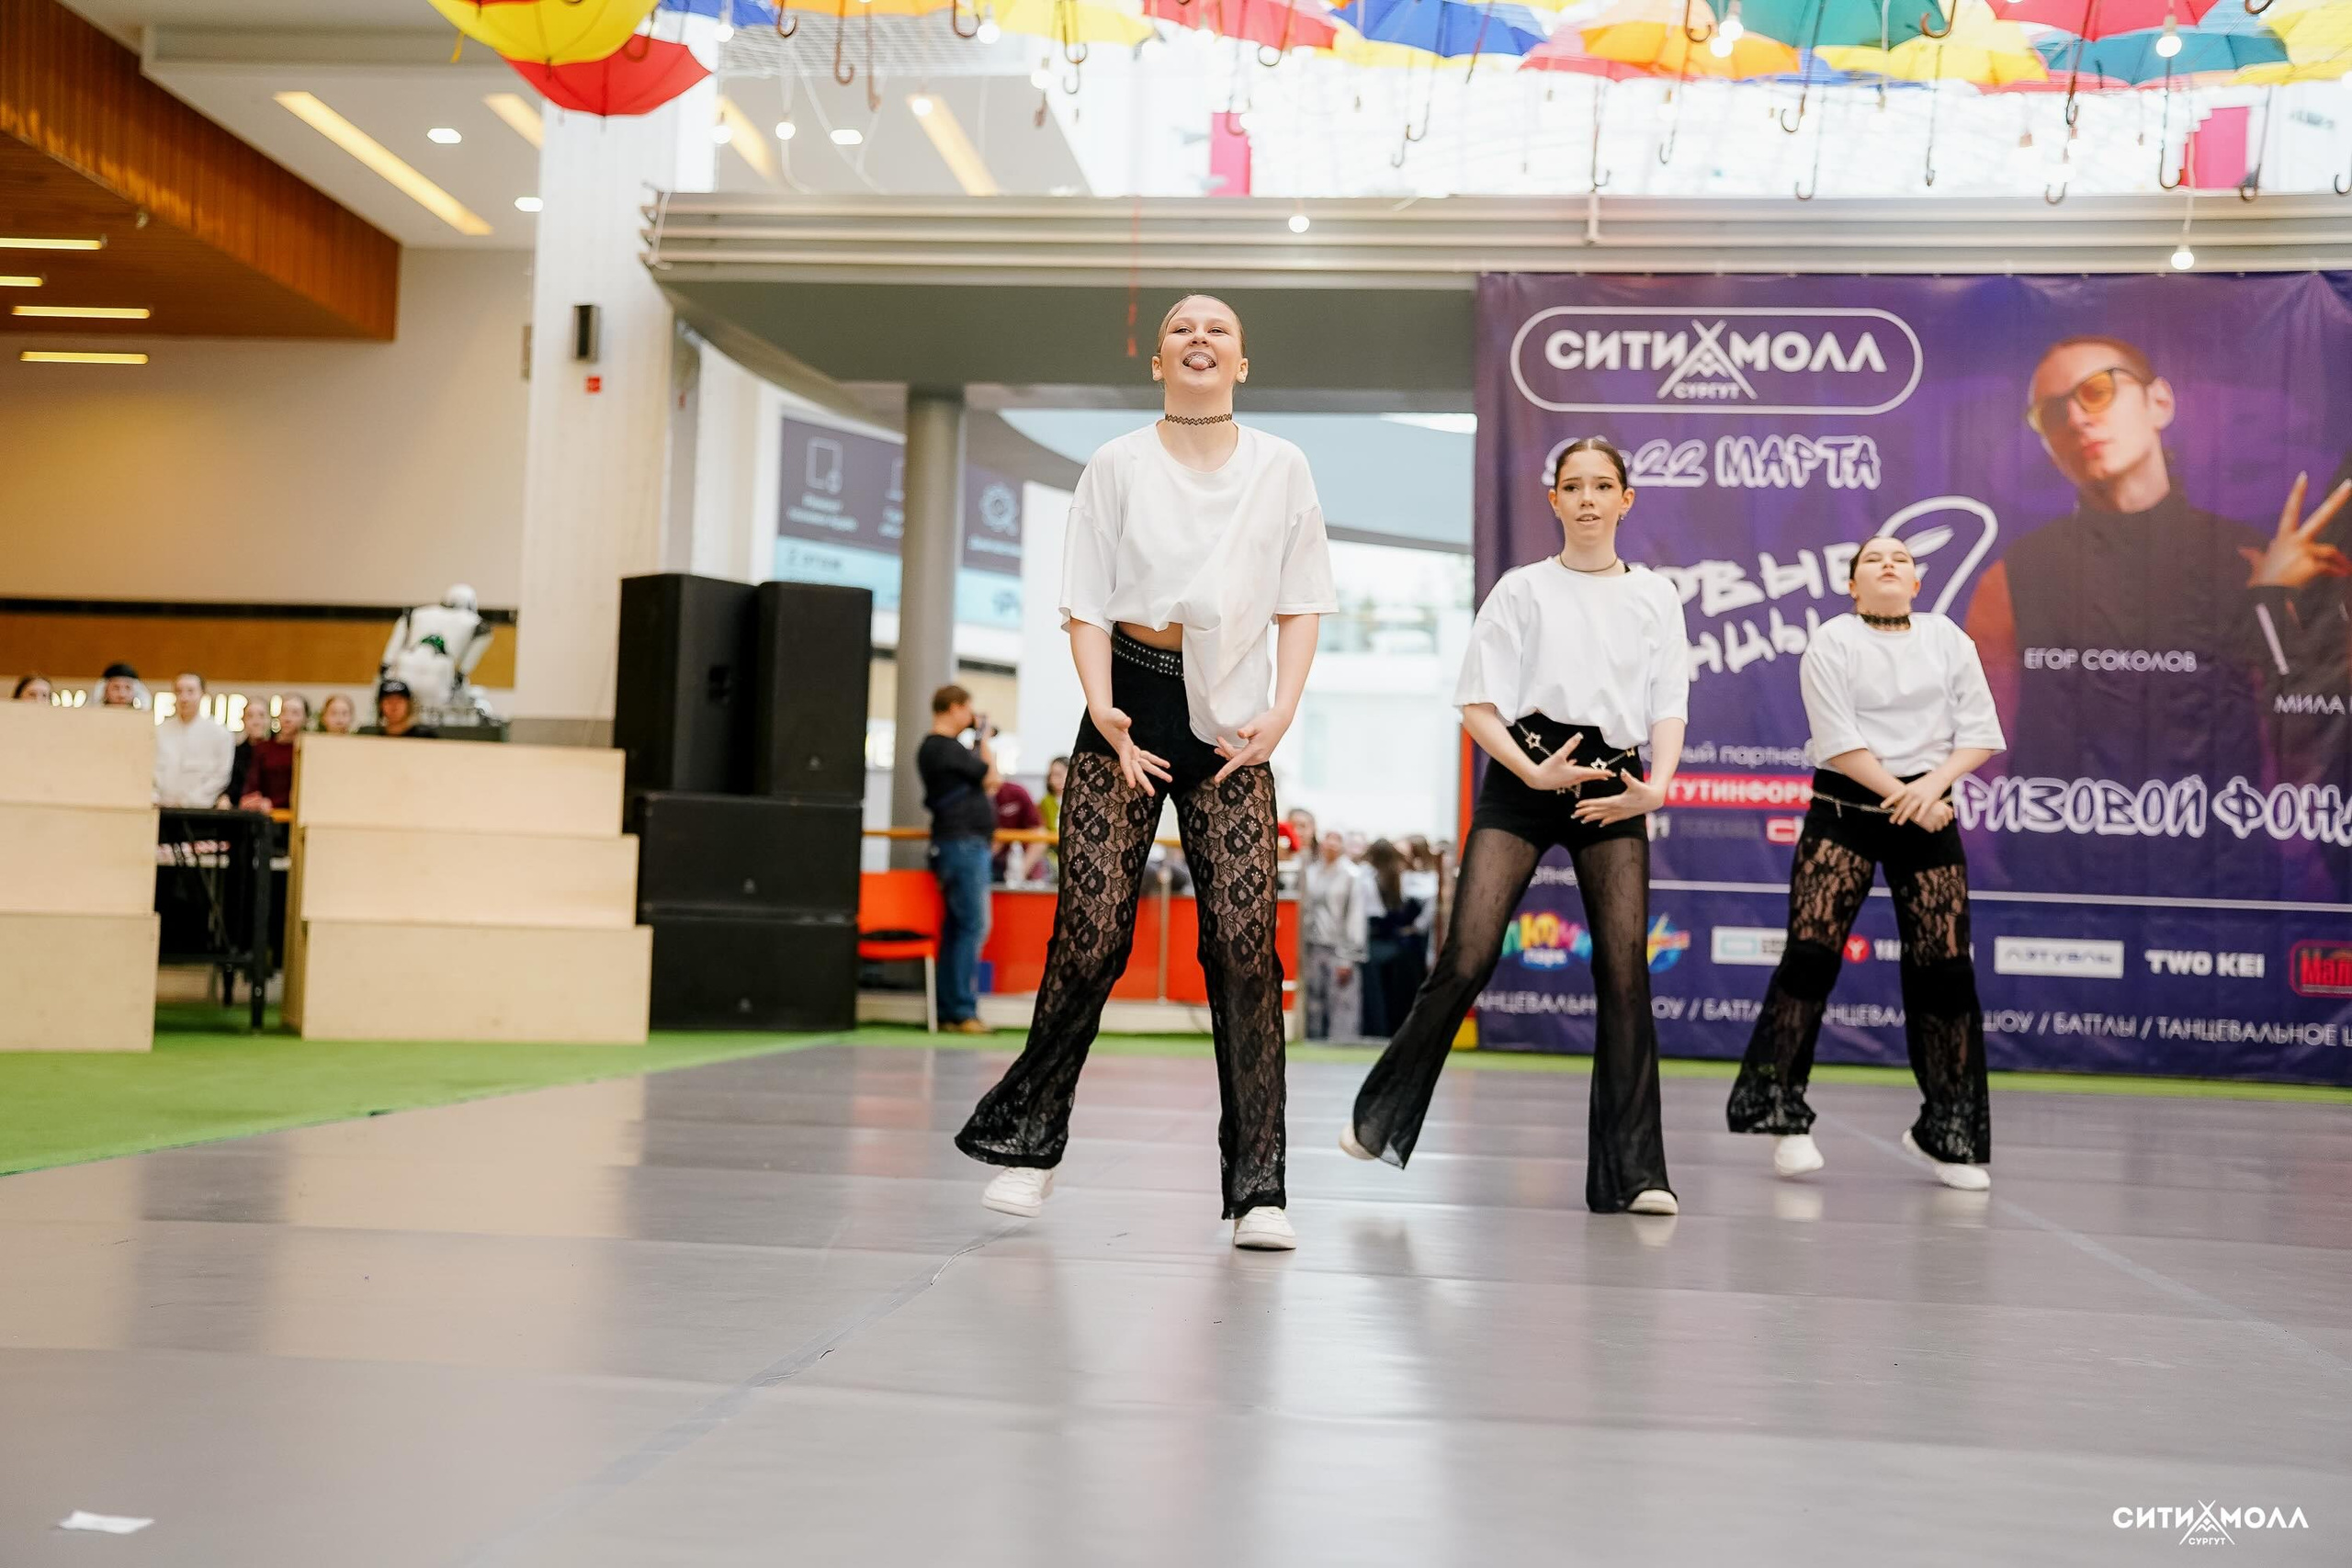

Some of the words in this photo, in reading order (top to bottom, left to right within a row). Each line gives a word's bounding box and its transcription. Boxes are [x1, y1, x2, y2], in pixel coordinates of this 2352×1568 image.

[1714, 434, 1882, 490] МАРТА
[1651, 541, 1858, 617] ОВЫЕ
[2024, 648, 2078, 670] ЕГОР
[2081, 649, 2198, 672] СОКОЛОВ
[2274, 694, 2344, 715] МИЛА
[1953, 772, 2206, 838] РИЗОВОЙ
[2211, 775, 2352, 847] ФОН
[2144, 949, 2213, 976] TWO
[2216, 953, 2266, 978] KEI
[2156, 1016, 2338, 1047] ТАНЦЕВАЛЬНОЕ
